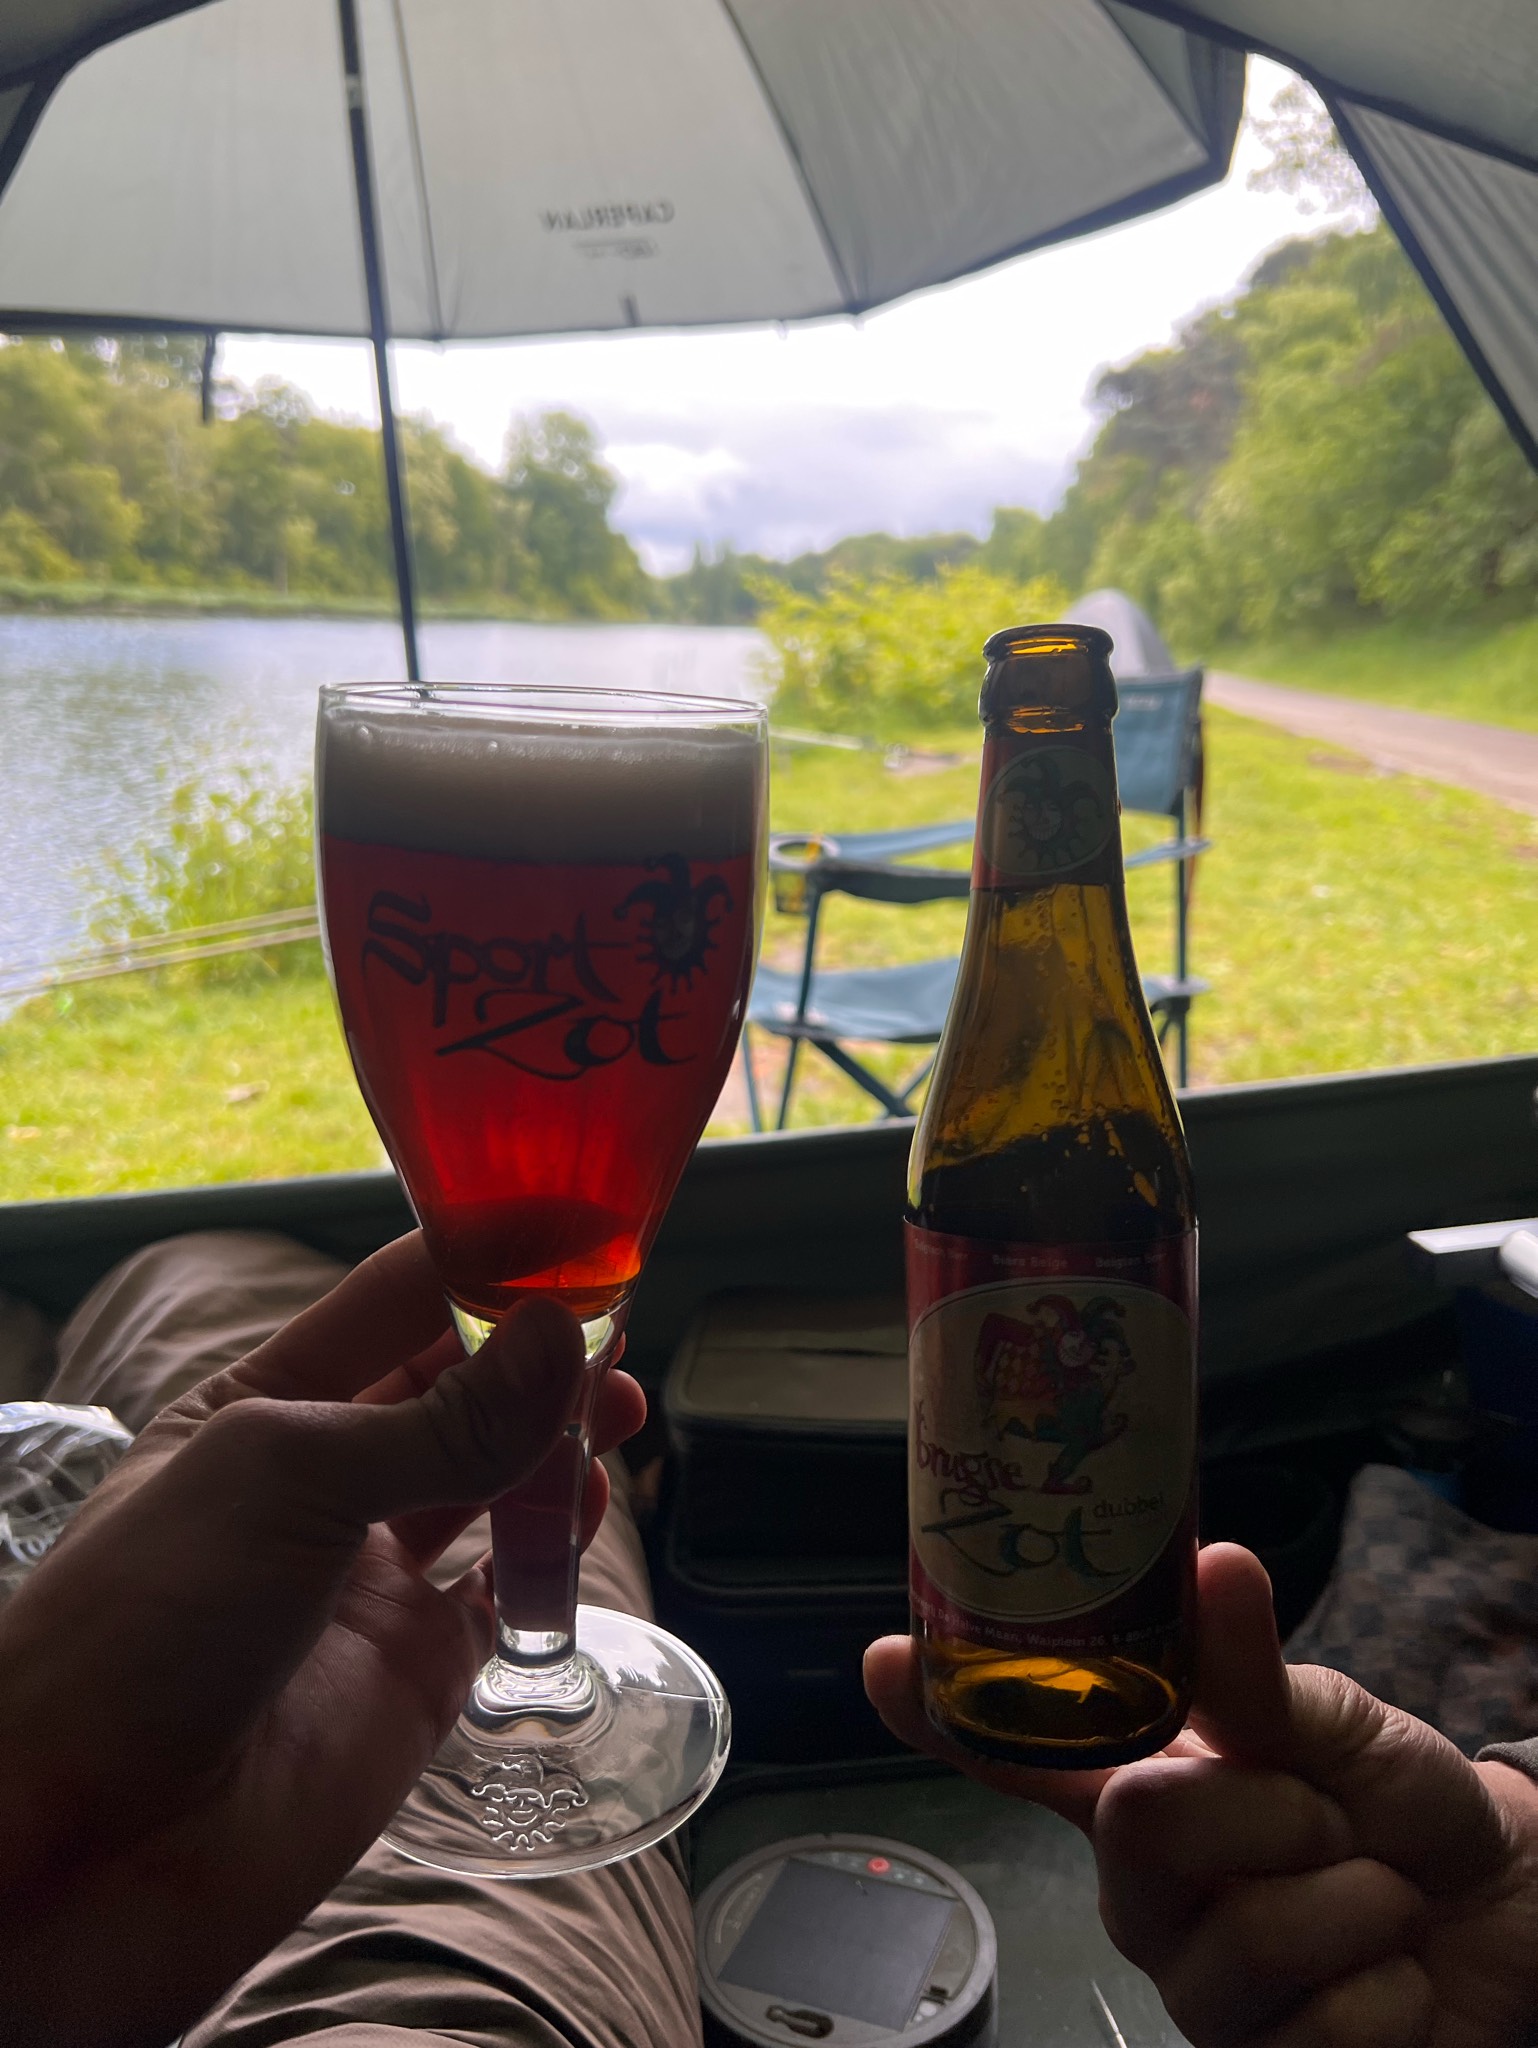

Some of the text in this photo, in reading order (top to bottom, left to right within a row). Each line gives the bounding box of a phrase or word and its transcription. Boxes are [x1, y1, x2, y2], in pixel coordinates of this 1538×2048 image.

[362, 889, 633, 1028] Sport
[436, 987, 697, 1081] Zot
[921, 1485, 1132, 1578] Zot
